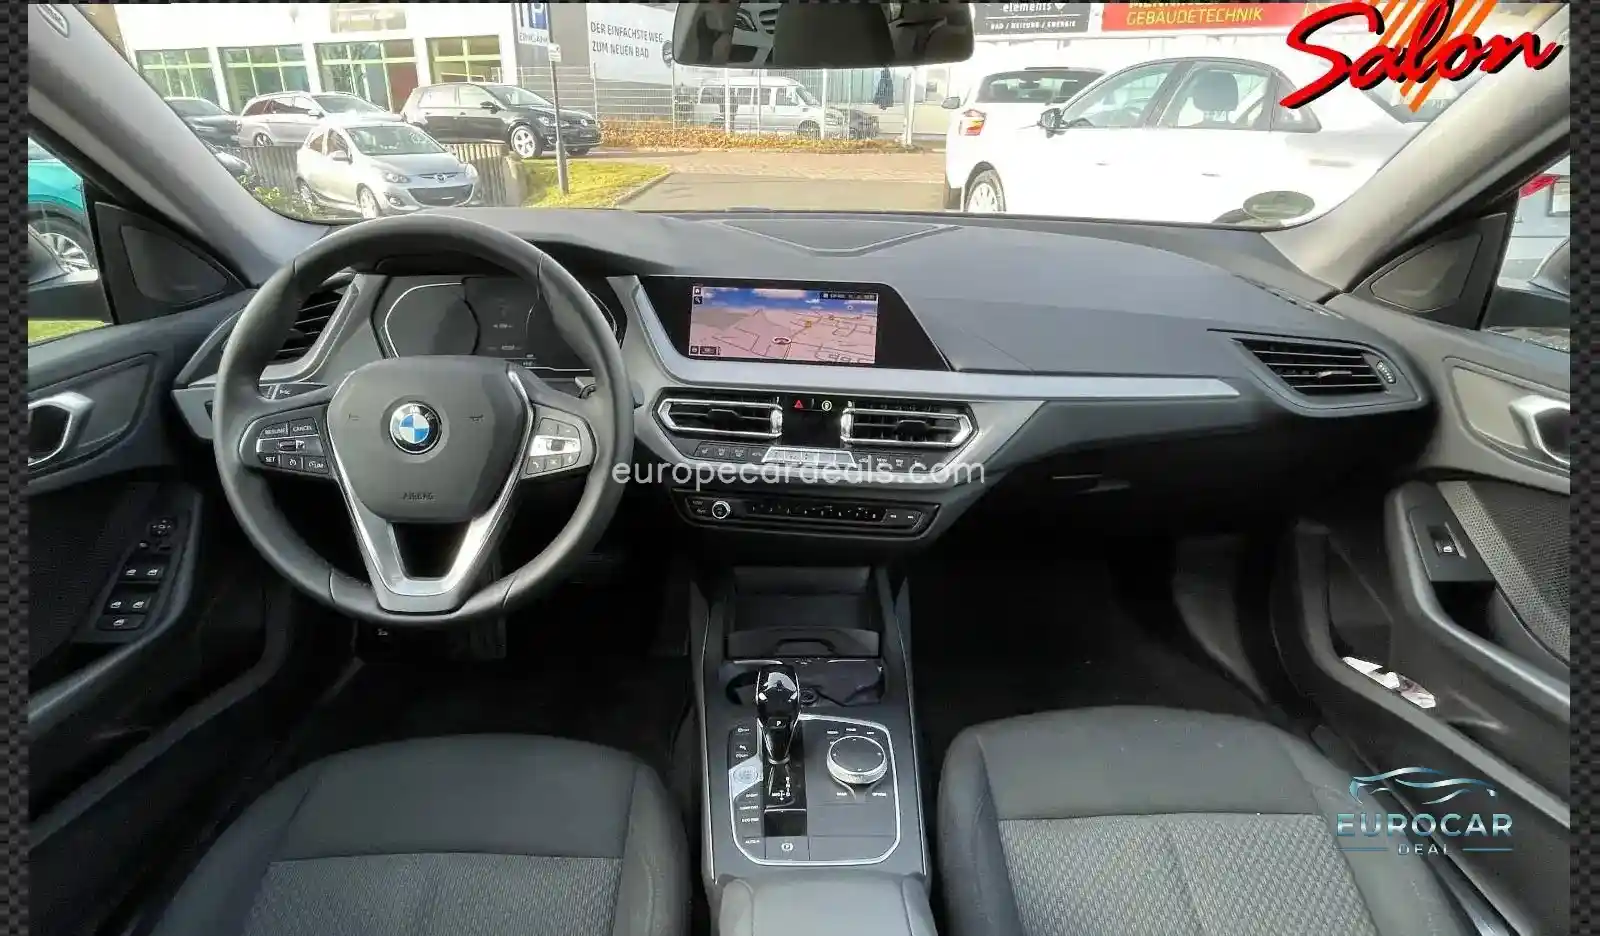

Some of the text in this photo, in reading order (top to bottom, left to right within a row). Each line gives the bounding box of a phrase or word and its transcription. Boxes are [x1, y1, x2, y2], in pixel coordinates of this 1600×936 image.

[590, 21, 664, 43] DER EINFACHSTE WEG
[592, 40, 649, 58] ZUM NEUEN BAD
